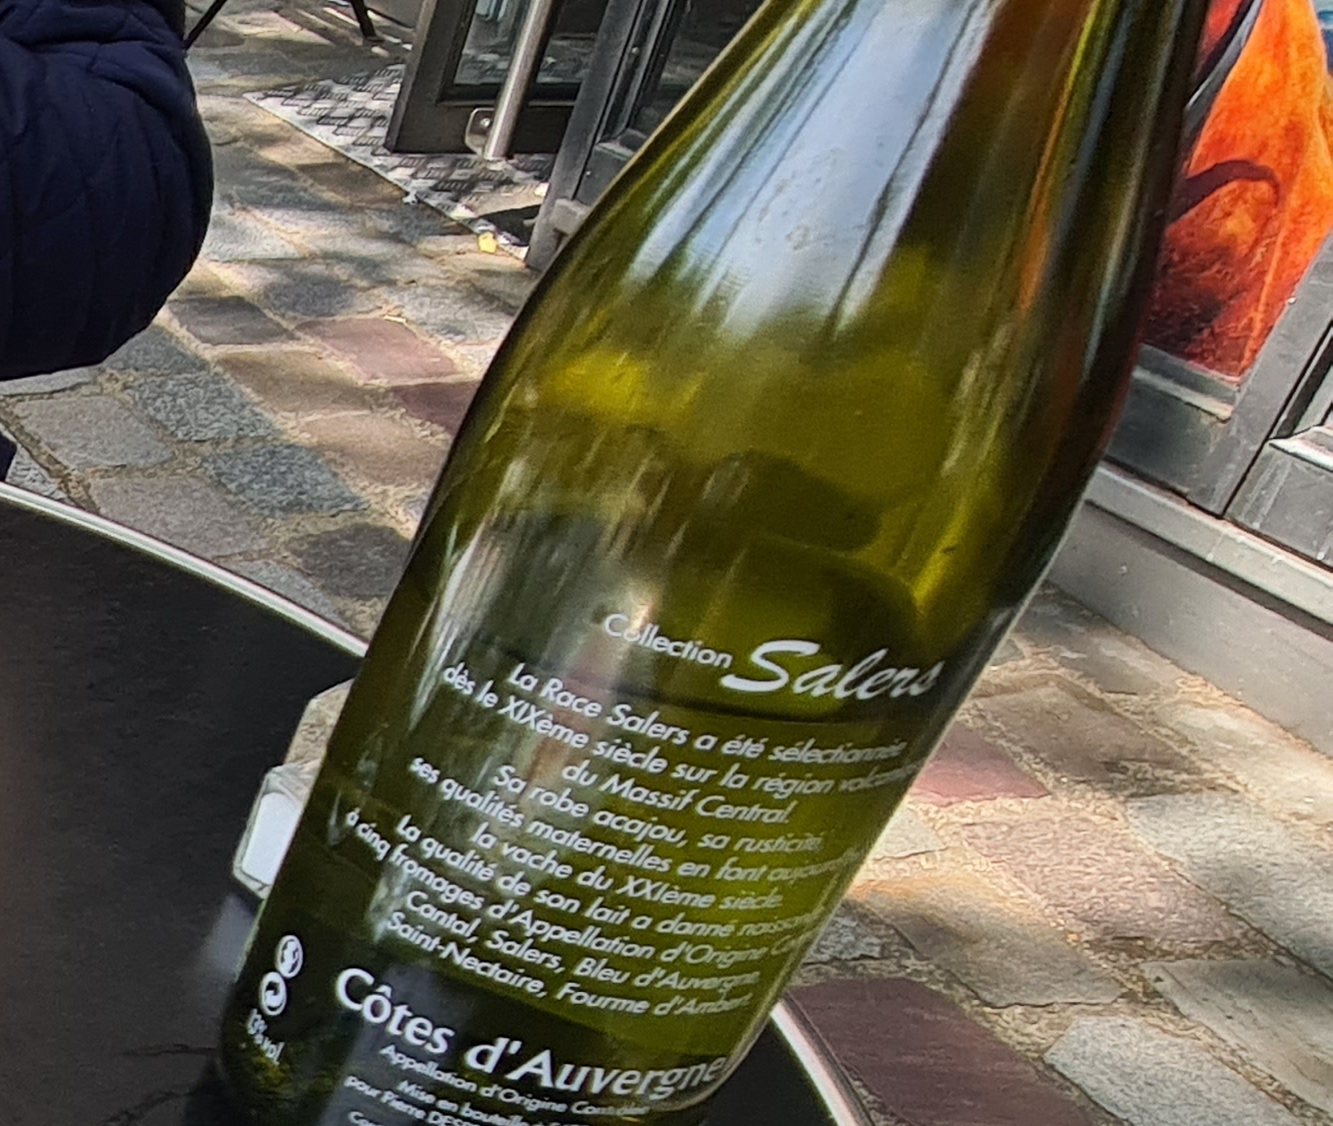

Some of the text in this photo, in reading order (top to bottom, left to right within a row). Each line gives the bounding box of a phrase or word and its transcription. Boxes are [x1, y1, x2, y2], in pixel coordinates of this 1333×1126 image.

[604, 614, 945, 699] Collection Salers
[443, 661, 476, 695] dès
[476, 679, 500, 708] le
[498, 695, 589, 748] XIXème
[592, 738, 668, 774] siècle
[671, 762, 718, 783] sur
[719, 762, 749, 790] la
[751, 773, 836, 800] région
[507, 662, 539, 691] La
[539, 678, 602, 718] Race
[606, 703, 689, 746] Salers
[694, 734, 719, 751] a
[721, 734, 769, 759] été
[410, 757, 440, 784] ses
[440, 778, 525, 828] qualités
[527, 819, 672, 873] maternelles
[677, 861, 711, 878] en
[715, 856, 768, 882] font
[493, 764, 527, 793] Sa
[528, 787, 590, 818] robe
[593, 810, 688, 847] acajou,
[698, 833, 731, 849] sa
[561, 759, 798, 825] du Massif Central.
[346, 807, 360, 827] à
[356, 821, 392, 862] cinq
[388, 843, 485, 911] fromages
[487, 899, 655, 959] d'Appellation
[660, 941, 770, 969] d'Origine
[396, 814, 421, 842] La
[421, 837, 498, 882] qualité
[495, 871, 531, 896] de
[535, 889, 581, 914] son
[585, 897, 631, 925] lait
[632, 915, 653, 930] a
[657, 912, 737, 938] donné
[469, 821, 497, 850] la
[501, 842, 573, 879] vache
[576, 865, 614, 891] du
[615, 874, 716, 909] XXIème
[387, 911, 549, 998] Saint-Nectaire,
[556, 982, 651, 1014] Fourme
[406, 890, 481, 943] Cantal,
[485, 930, 565, 974] Salers,
[573, 956, 631, 984] Bleu
[336, 967, 727, 1100] Côtes d'Auvergne
[380, 1044, 477, 1092] Appellation
[479, 1083, 569, 1112] d'Origine
[344, 1075, 381, 1099] pour
[381, 1090, 426, 1120] Pierre
[397, 1079, 436, 1104] Mise
[436, 1100, 459, 1112] en
